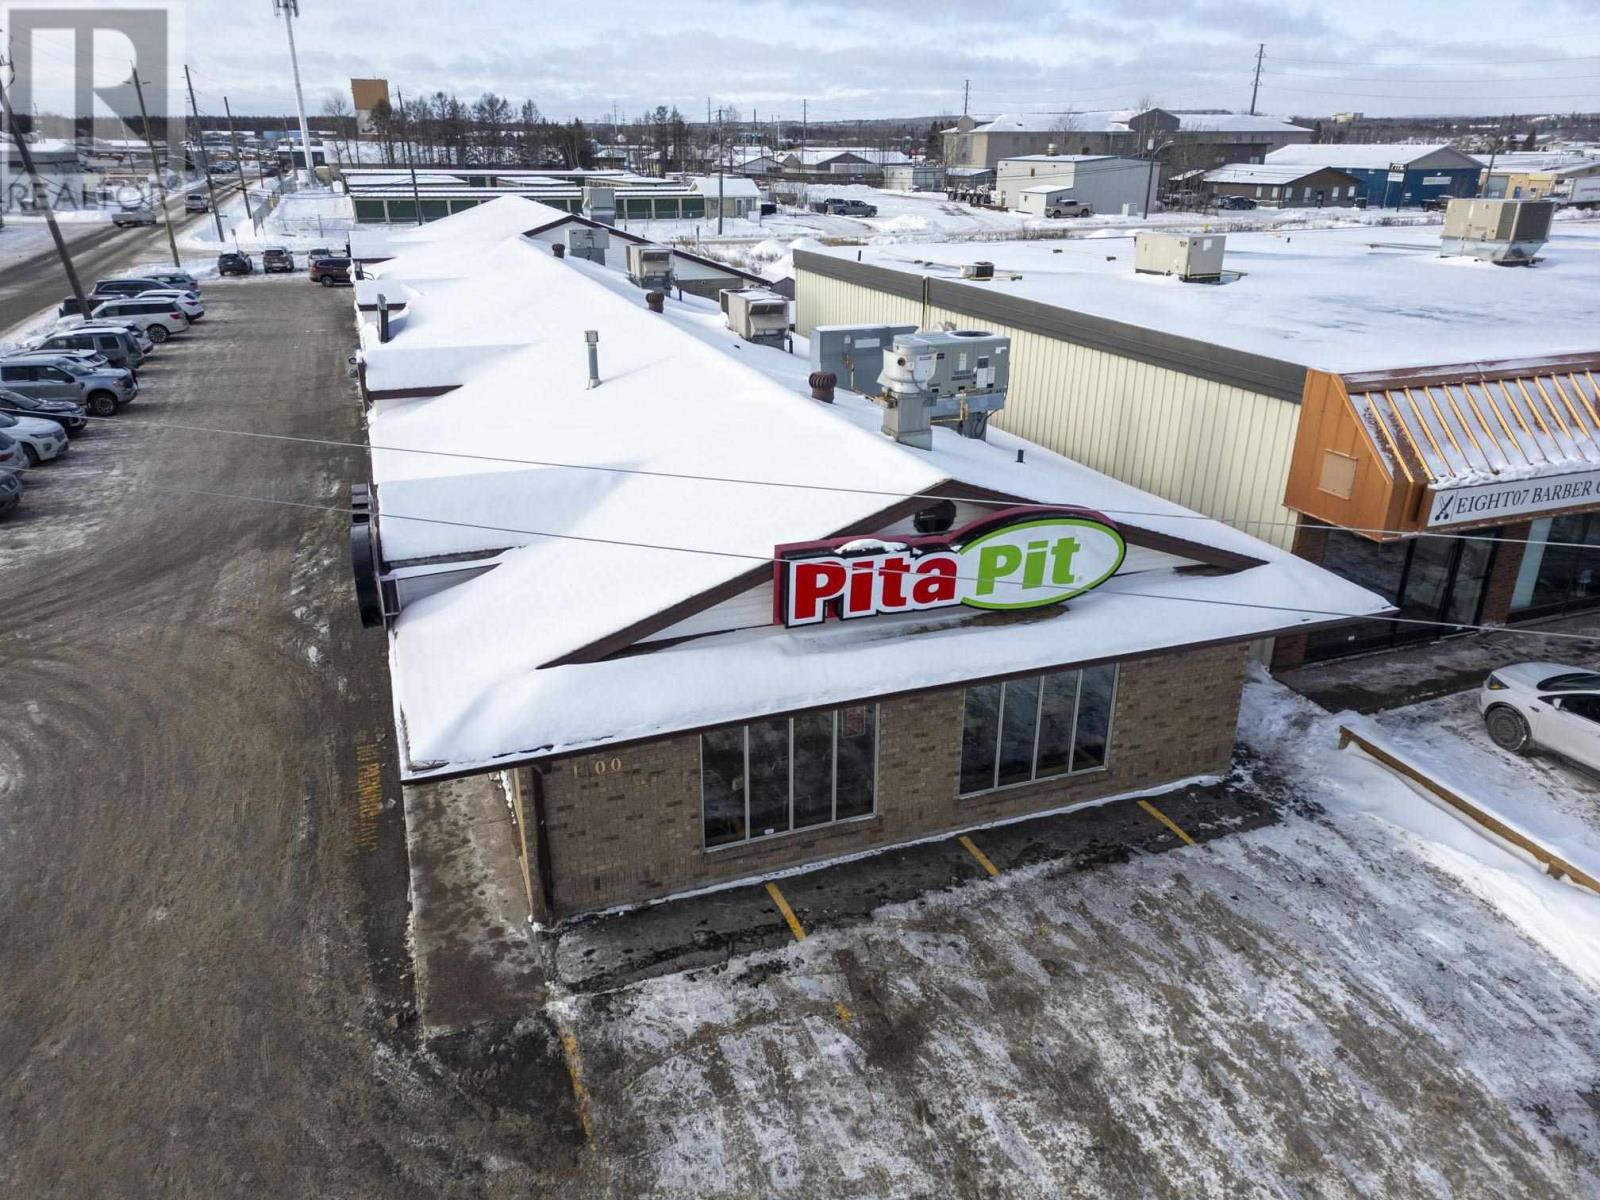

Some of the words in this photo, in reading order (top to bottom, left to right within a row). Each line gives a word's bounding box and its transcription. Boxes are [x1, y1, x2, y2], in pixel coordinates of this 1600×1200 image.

[1455, 489, 1530, 514] EIGHT07
[1532, 480, 1593, 503] BARBER
[794, 556, 958, 620] Pita
[975, 536, 1081, 596] Pit
